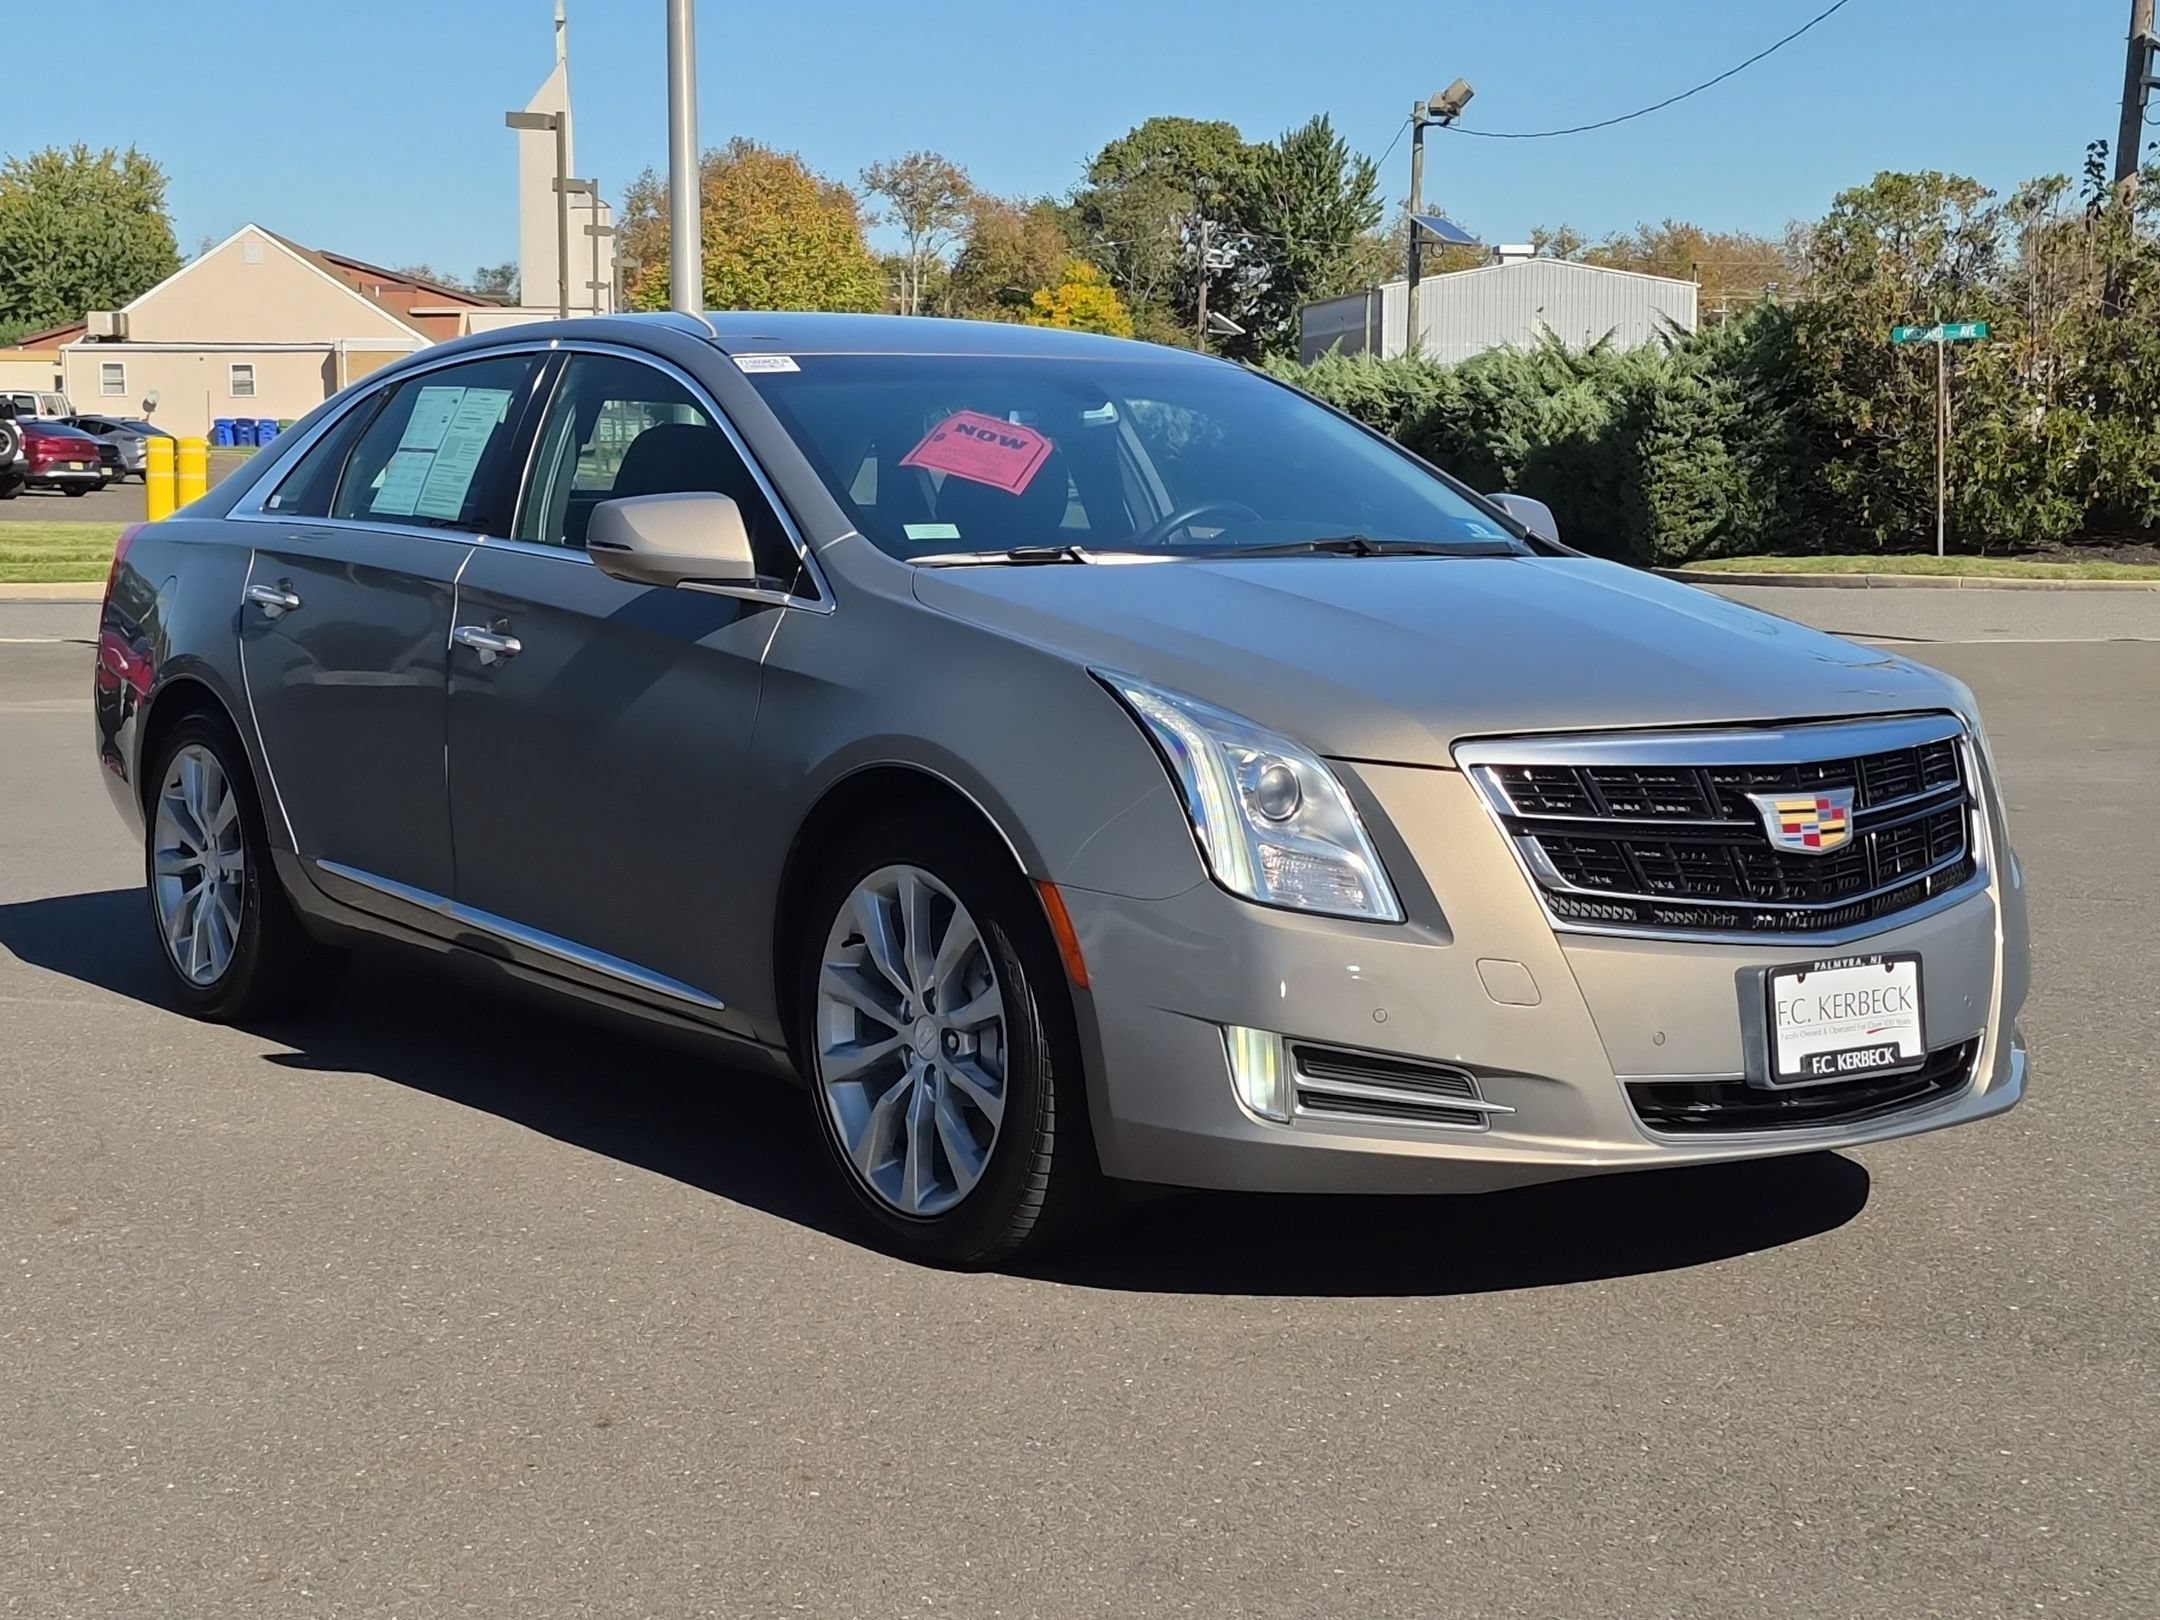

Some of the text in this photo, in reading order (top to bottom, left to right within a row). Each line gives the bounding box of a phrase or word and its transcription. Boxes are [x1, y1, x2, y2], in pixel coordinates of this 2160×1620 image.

[1960, 325, 1977, 337] AVE
[953, 423, 1028, 450] NOW
[1814, 955, 1882, 971] PALMYRA, NJ
[1778, 985, 1912, 1026] F.C. KERBECK
[1799, 1028, 1822, 1039] Owned
[1829, 1024, 1856, 1035] Operated
[1857, 1023, 1866, 1031] For
[1812, 1047, 1895, 1075] F.C. KERBECK
